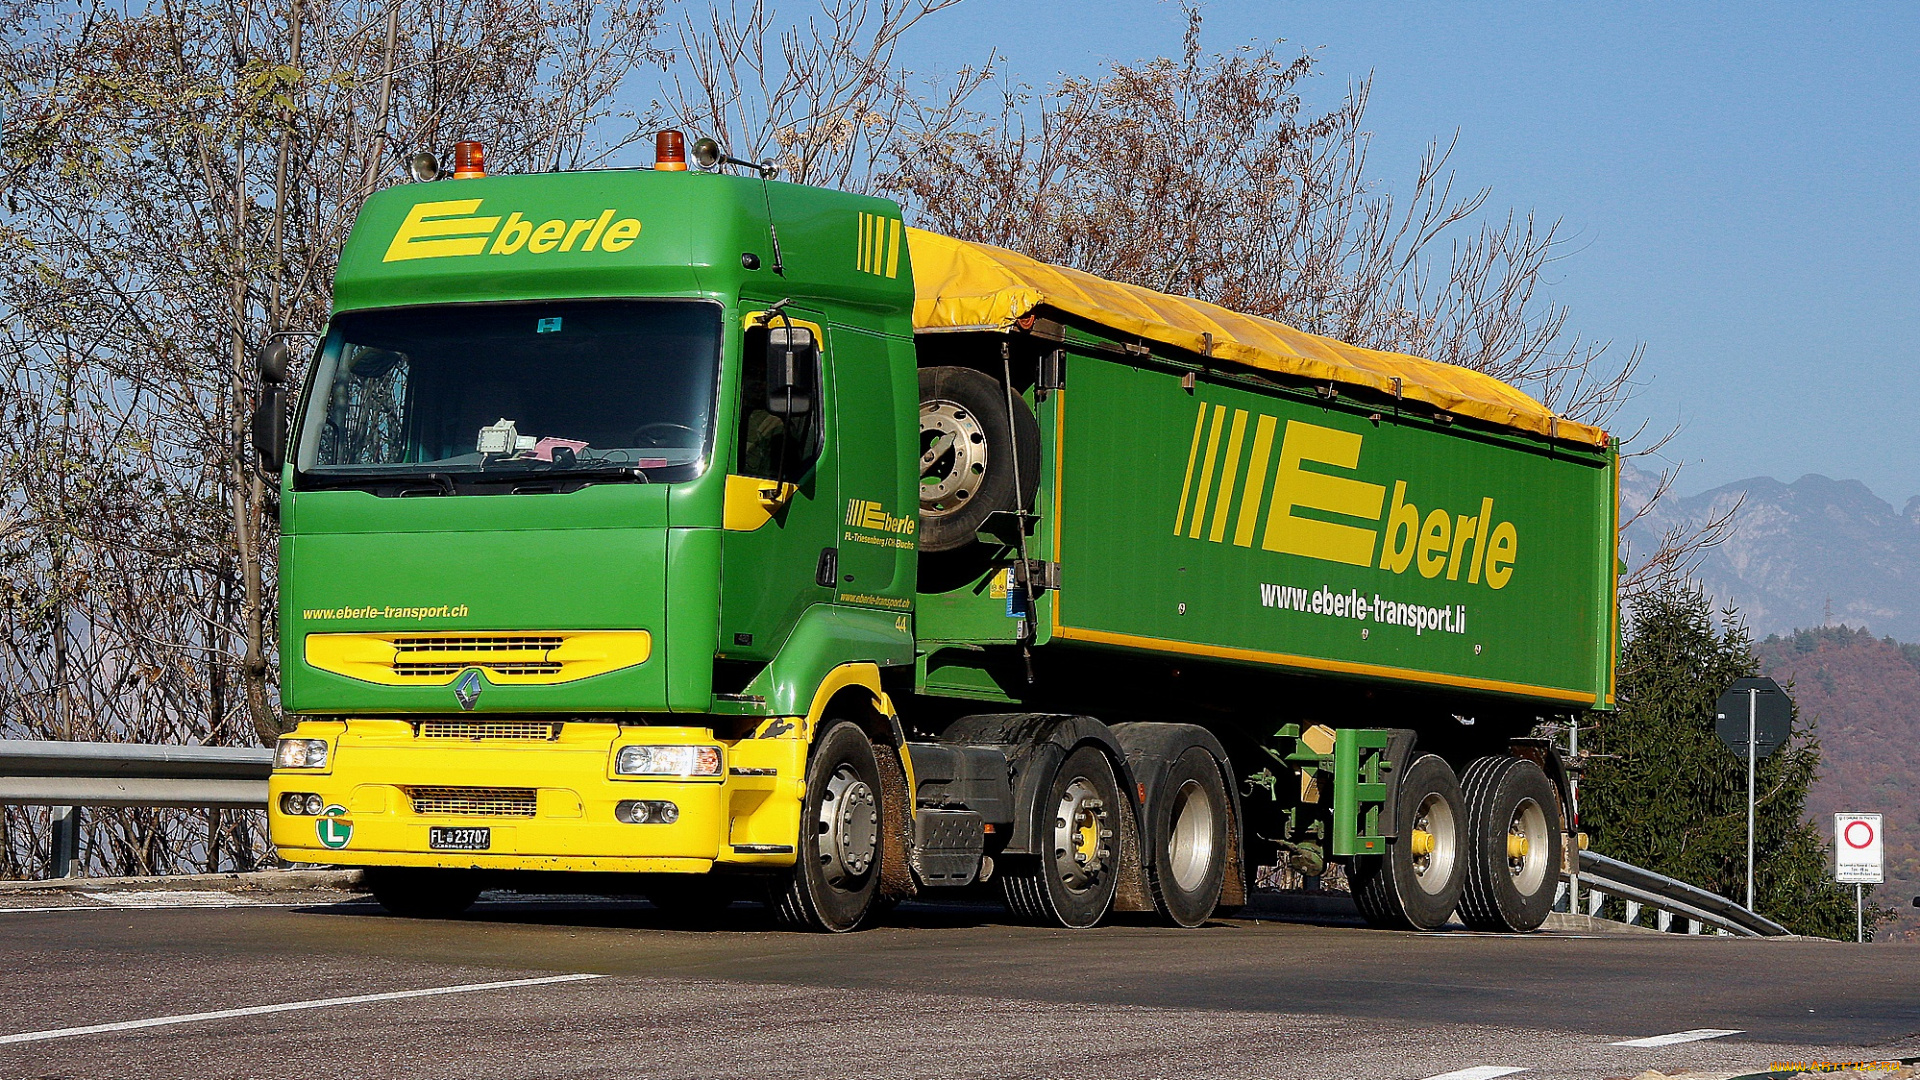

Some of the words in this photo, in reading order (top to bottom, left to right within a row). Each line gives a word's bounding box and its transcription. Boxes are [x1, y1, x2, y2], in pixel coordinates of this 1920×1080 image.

[382, 198, 642, 263] Eberle
[862, 501, 915, 534] Eberle
[1261, 418, 1518, 590] Eberle
[303, 604, 469, 621] www.eberle-transport.ch
[895, 616, 907, 633] 44
[1260, 582, 1466, 636] www.eberle-transport.li
[326, 812, 344, 843] L
[431, 829, 445, 844] FL
[454, 829, 488, 844] 23707
